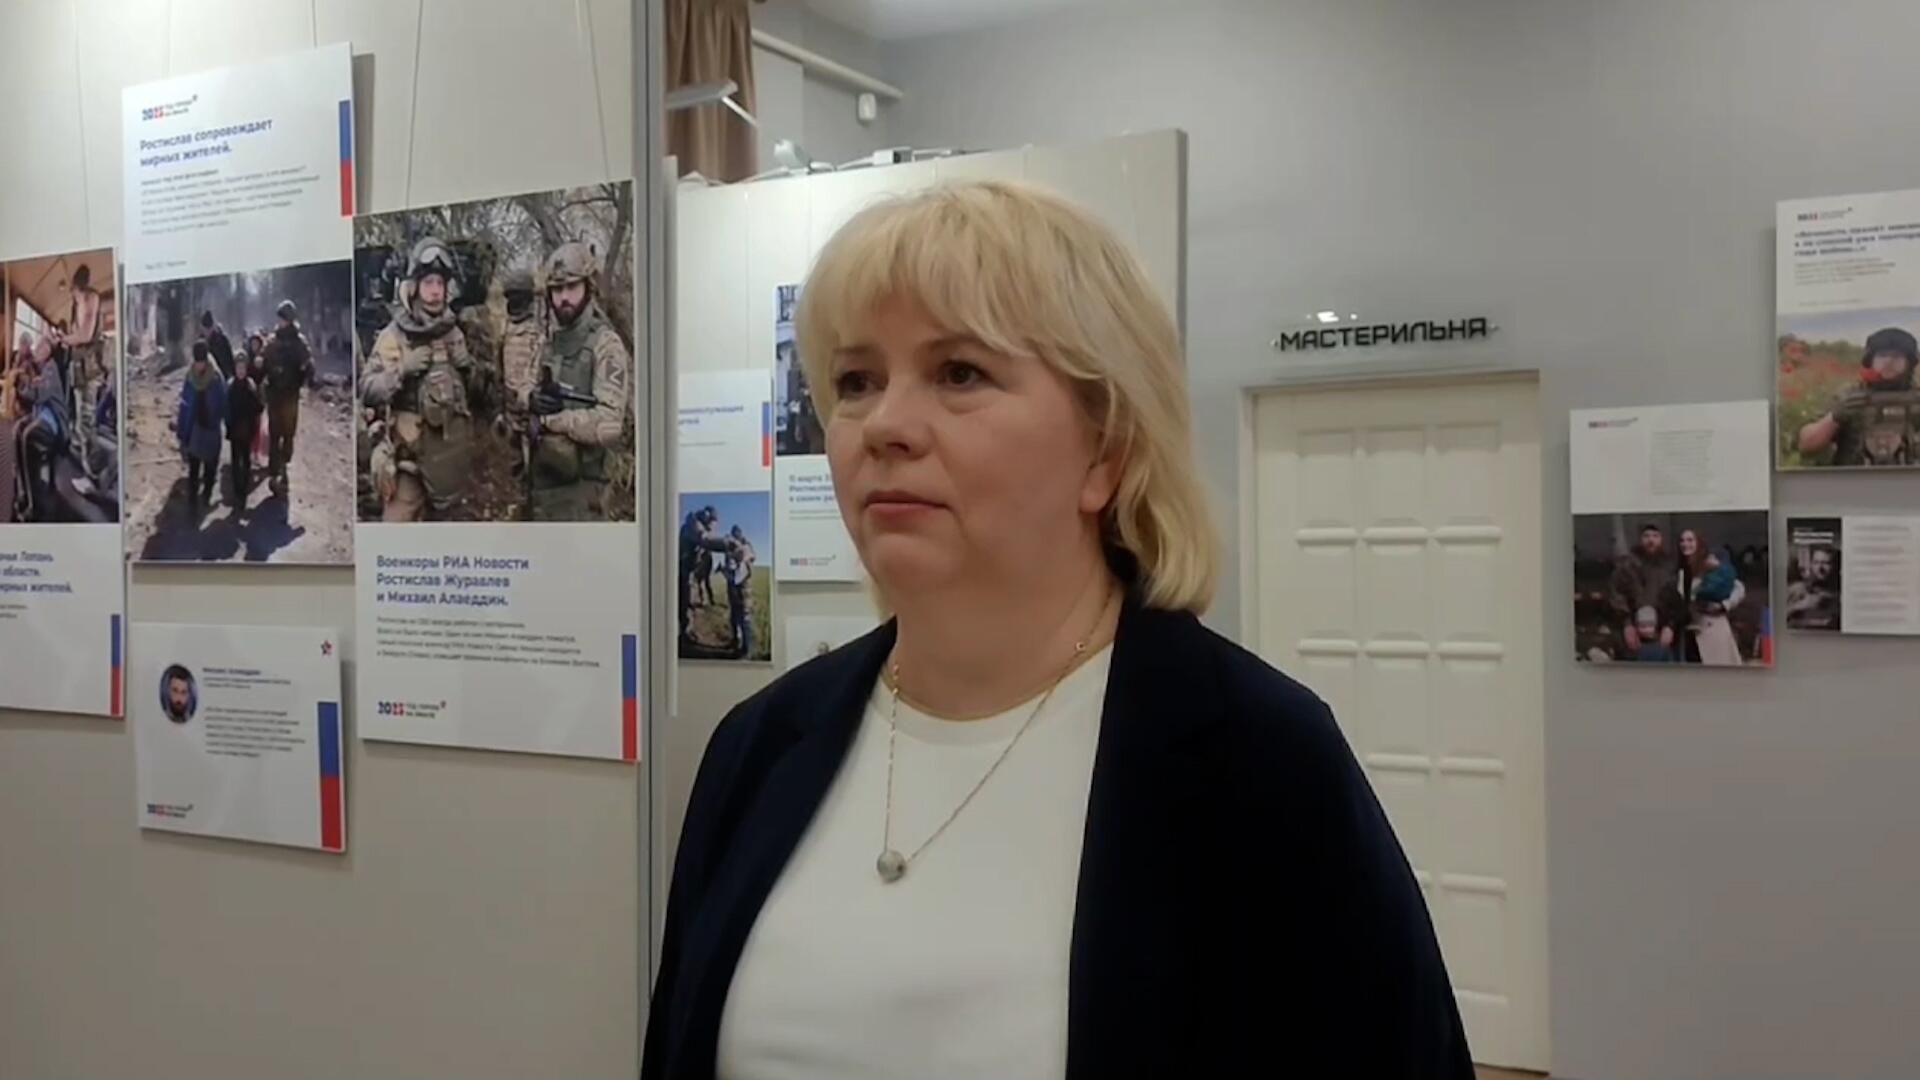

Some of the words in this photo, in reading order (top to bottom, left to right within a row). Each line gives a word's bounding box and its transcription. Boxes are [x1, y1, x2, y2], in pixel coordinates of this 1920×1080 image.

[139, 134, 192, 150] Ростислав
[194, 119, 273, 142] сопровождает
[140, 152, 180, 168] мирных
[1280, 317, 1487, 351] МАСТЕРИЛЬНЯ
[376, 555, 440, 571] Военкоры
[443, 556, 470, 569] РИА
[474, 557, 529, 570] Новости
[376, 573, 441, 587] Ростислав
[444, 575, 510, 589] Журавлев
[376, 592, 384, 602] и
[388, 592, 436, 604] Михаил
